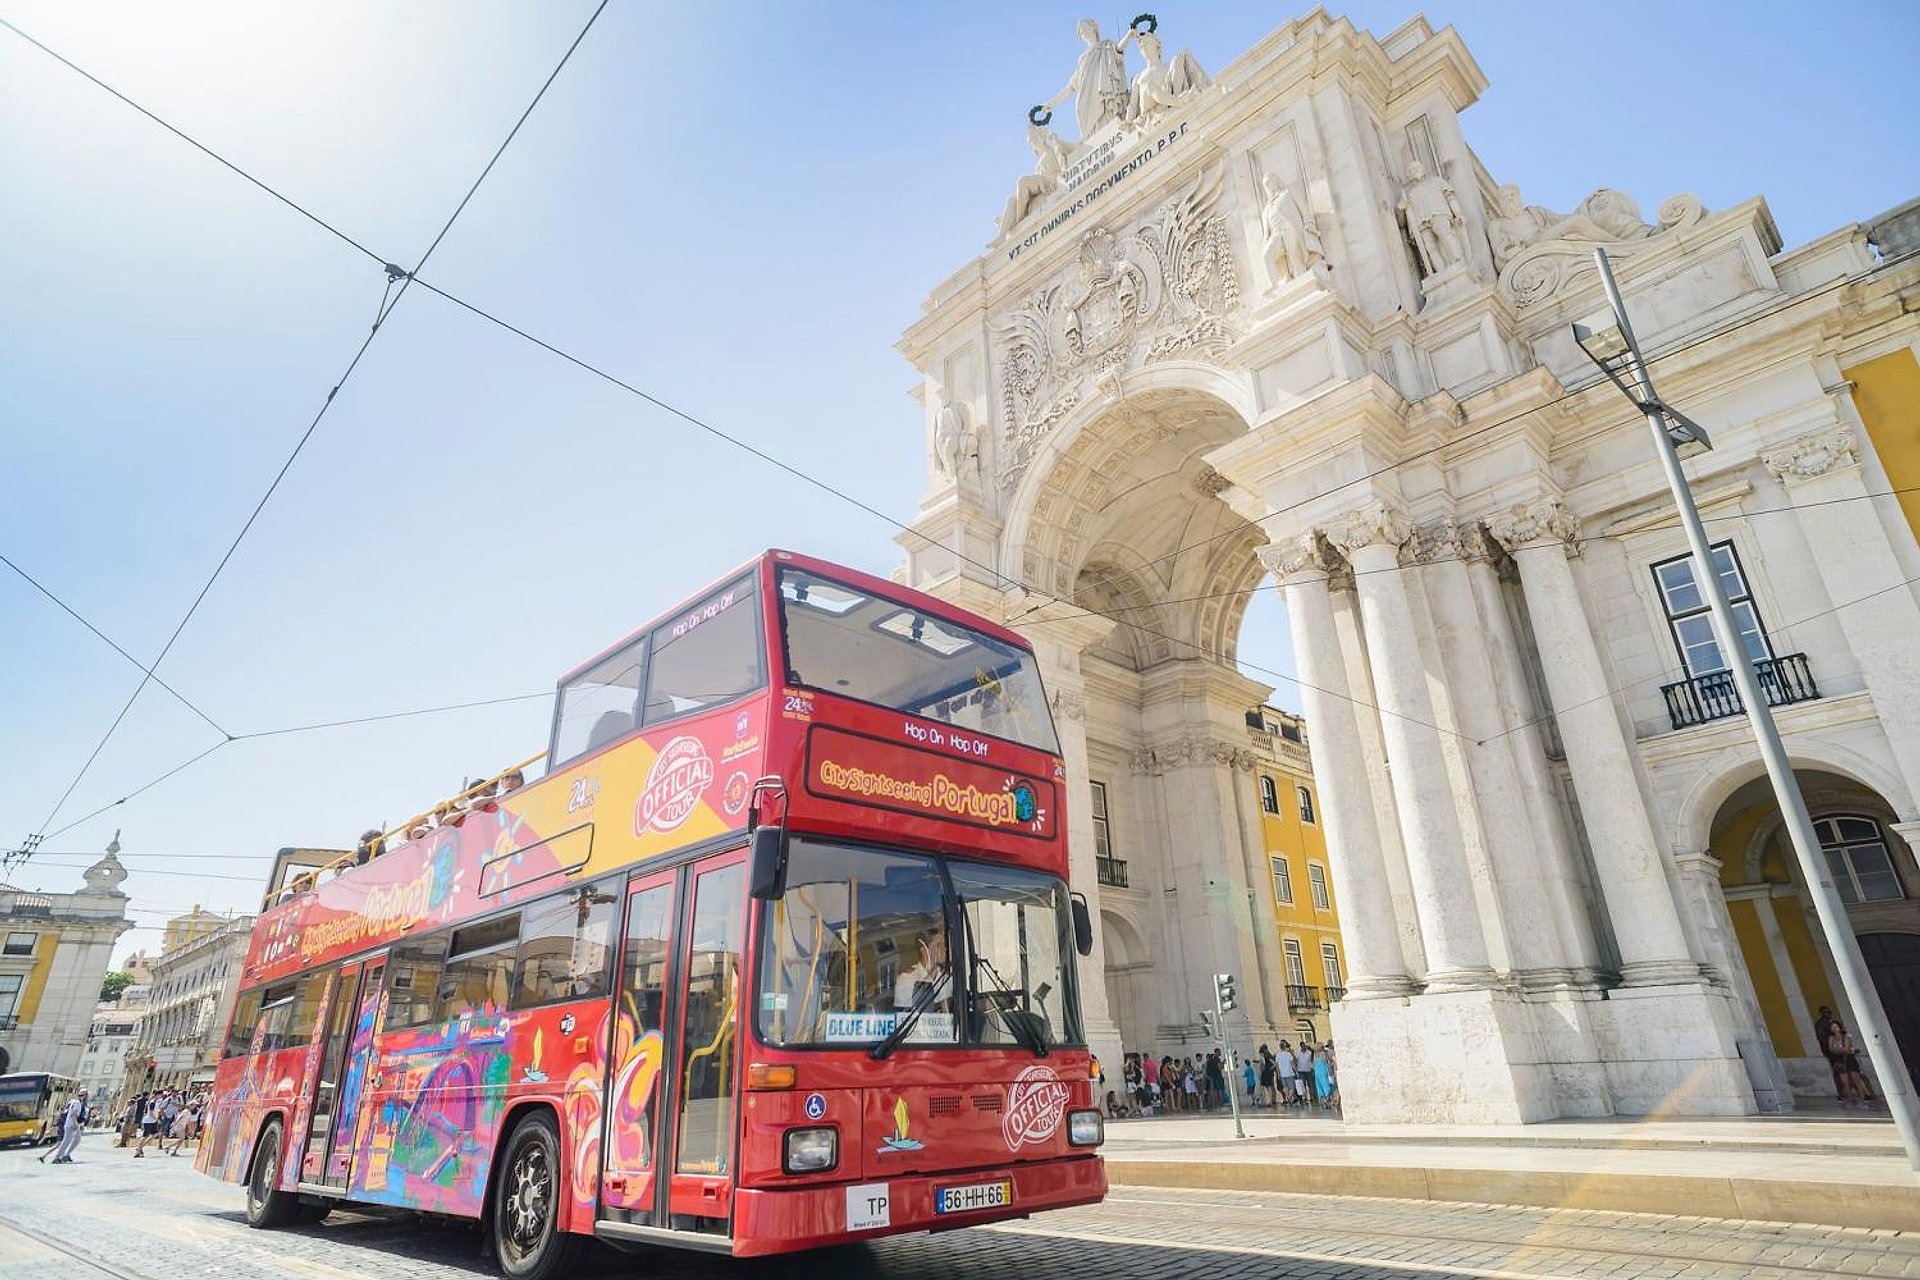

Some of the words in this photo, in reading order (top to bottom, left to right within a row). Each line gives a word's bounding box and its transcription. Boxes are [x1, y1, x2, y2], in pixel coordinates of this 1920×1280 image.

[1024, 231, 1039, 247] SIT
[904, 721, 927, 741] Hop
[929, 728, 945, 745] On
[950, 733, 971, 753] Hop
[972, 740, 989, 757] Off
[643, 759, 710, 820] OFFICIAL
[933, 774, 1018, 826] Portugal
[828, 1017, 863, 1036] BLUE
[865, 1019, 895, 1036] LINE
[1011, 1080, 1067, 1135] OFFICIAL
[1037, 1106, 1060, 1130] TOUR
[867, 1196, 888, 1216] TP
